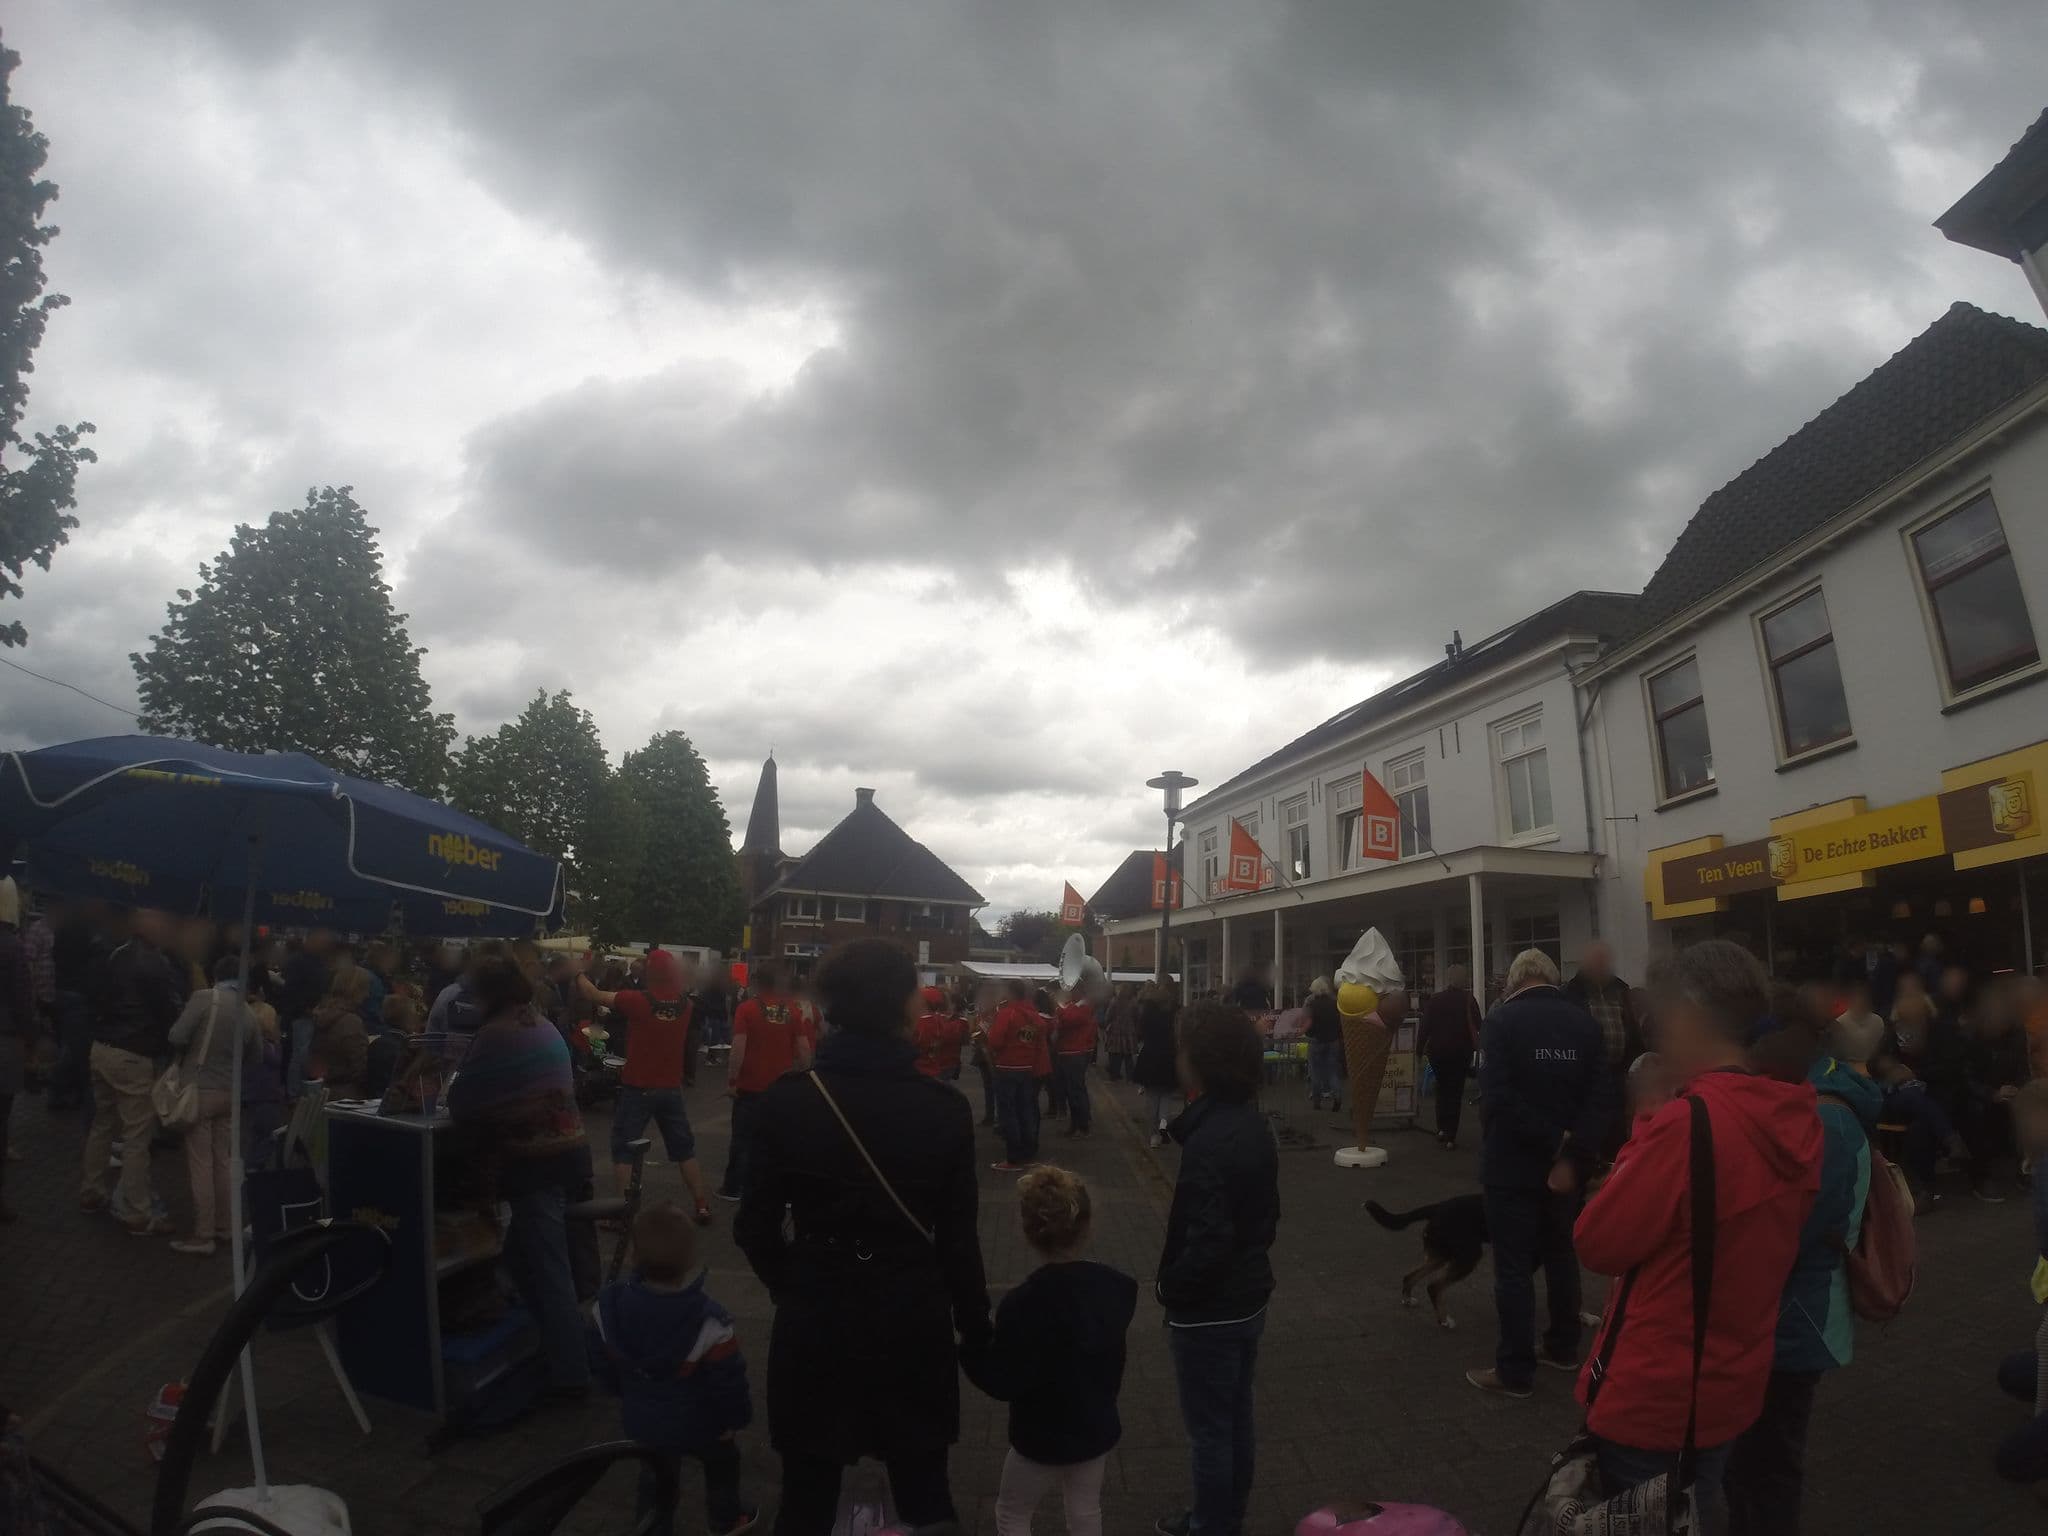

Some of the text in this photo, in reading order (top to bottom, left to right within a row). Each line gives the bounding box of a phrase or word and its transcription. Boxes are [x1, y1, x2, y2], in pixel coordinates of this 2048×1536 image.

[1803, 824, 1928, 864] De Echte Bakker
[1696, 859, 1765, 884] Ten Veen
